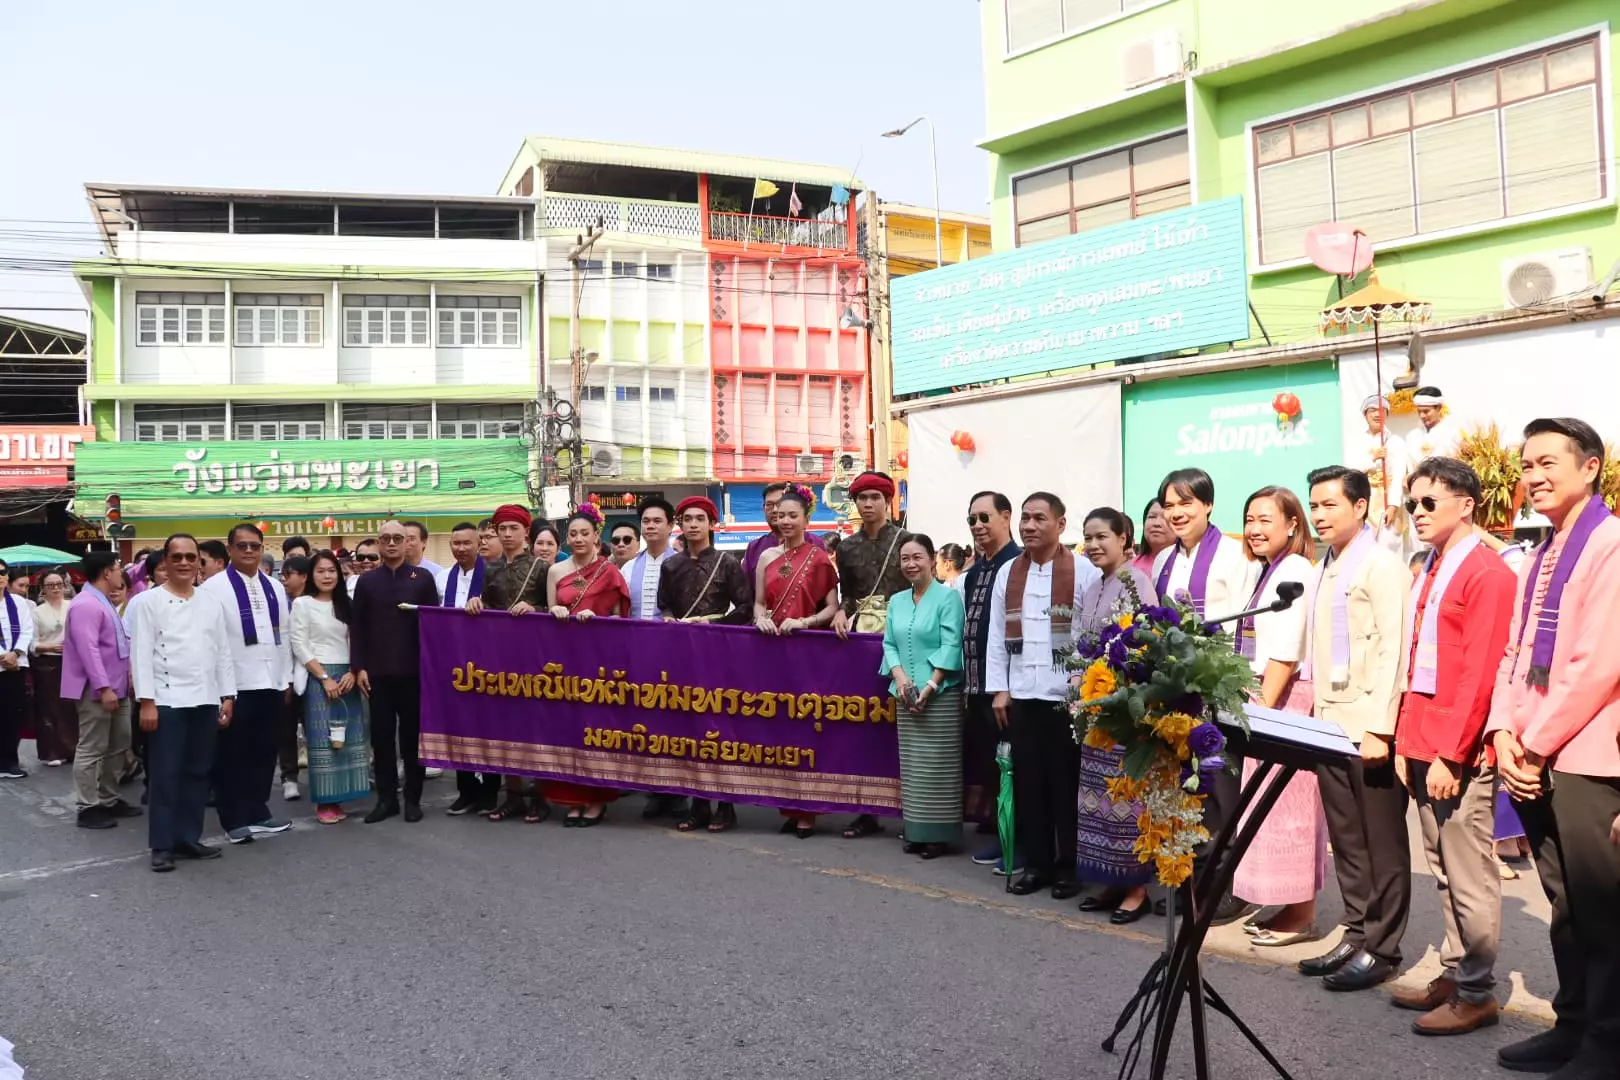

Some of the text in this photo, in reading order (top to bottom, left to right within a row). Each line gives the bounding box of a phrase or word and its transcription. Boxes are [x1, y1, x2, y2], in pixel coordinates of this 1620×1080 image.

[1174, 418, 1312, 456] Salonpas
[173, 448, 441, 493] วังแว่นพะเยา
[452, 661, 896, 732] ประเพณีแห่ผ้าห่มพระธาตุจอม
[583, 723, 815, 768] มหาวิทยาลัยพะเยา
